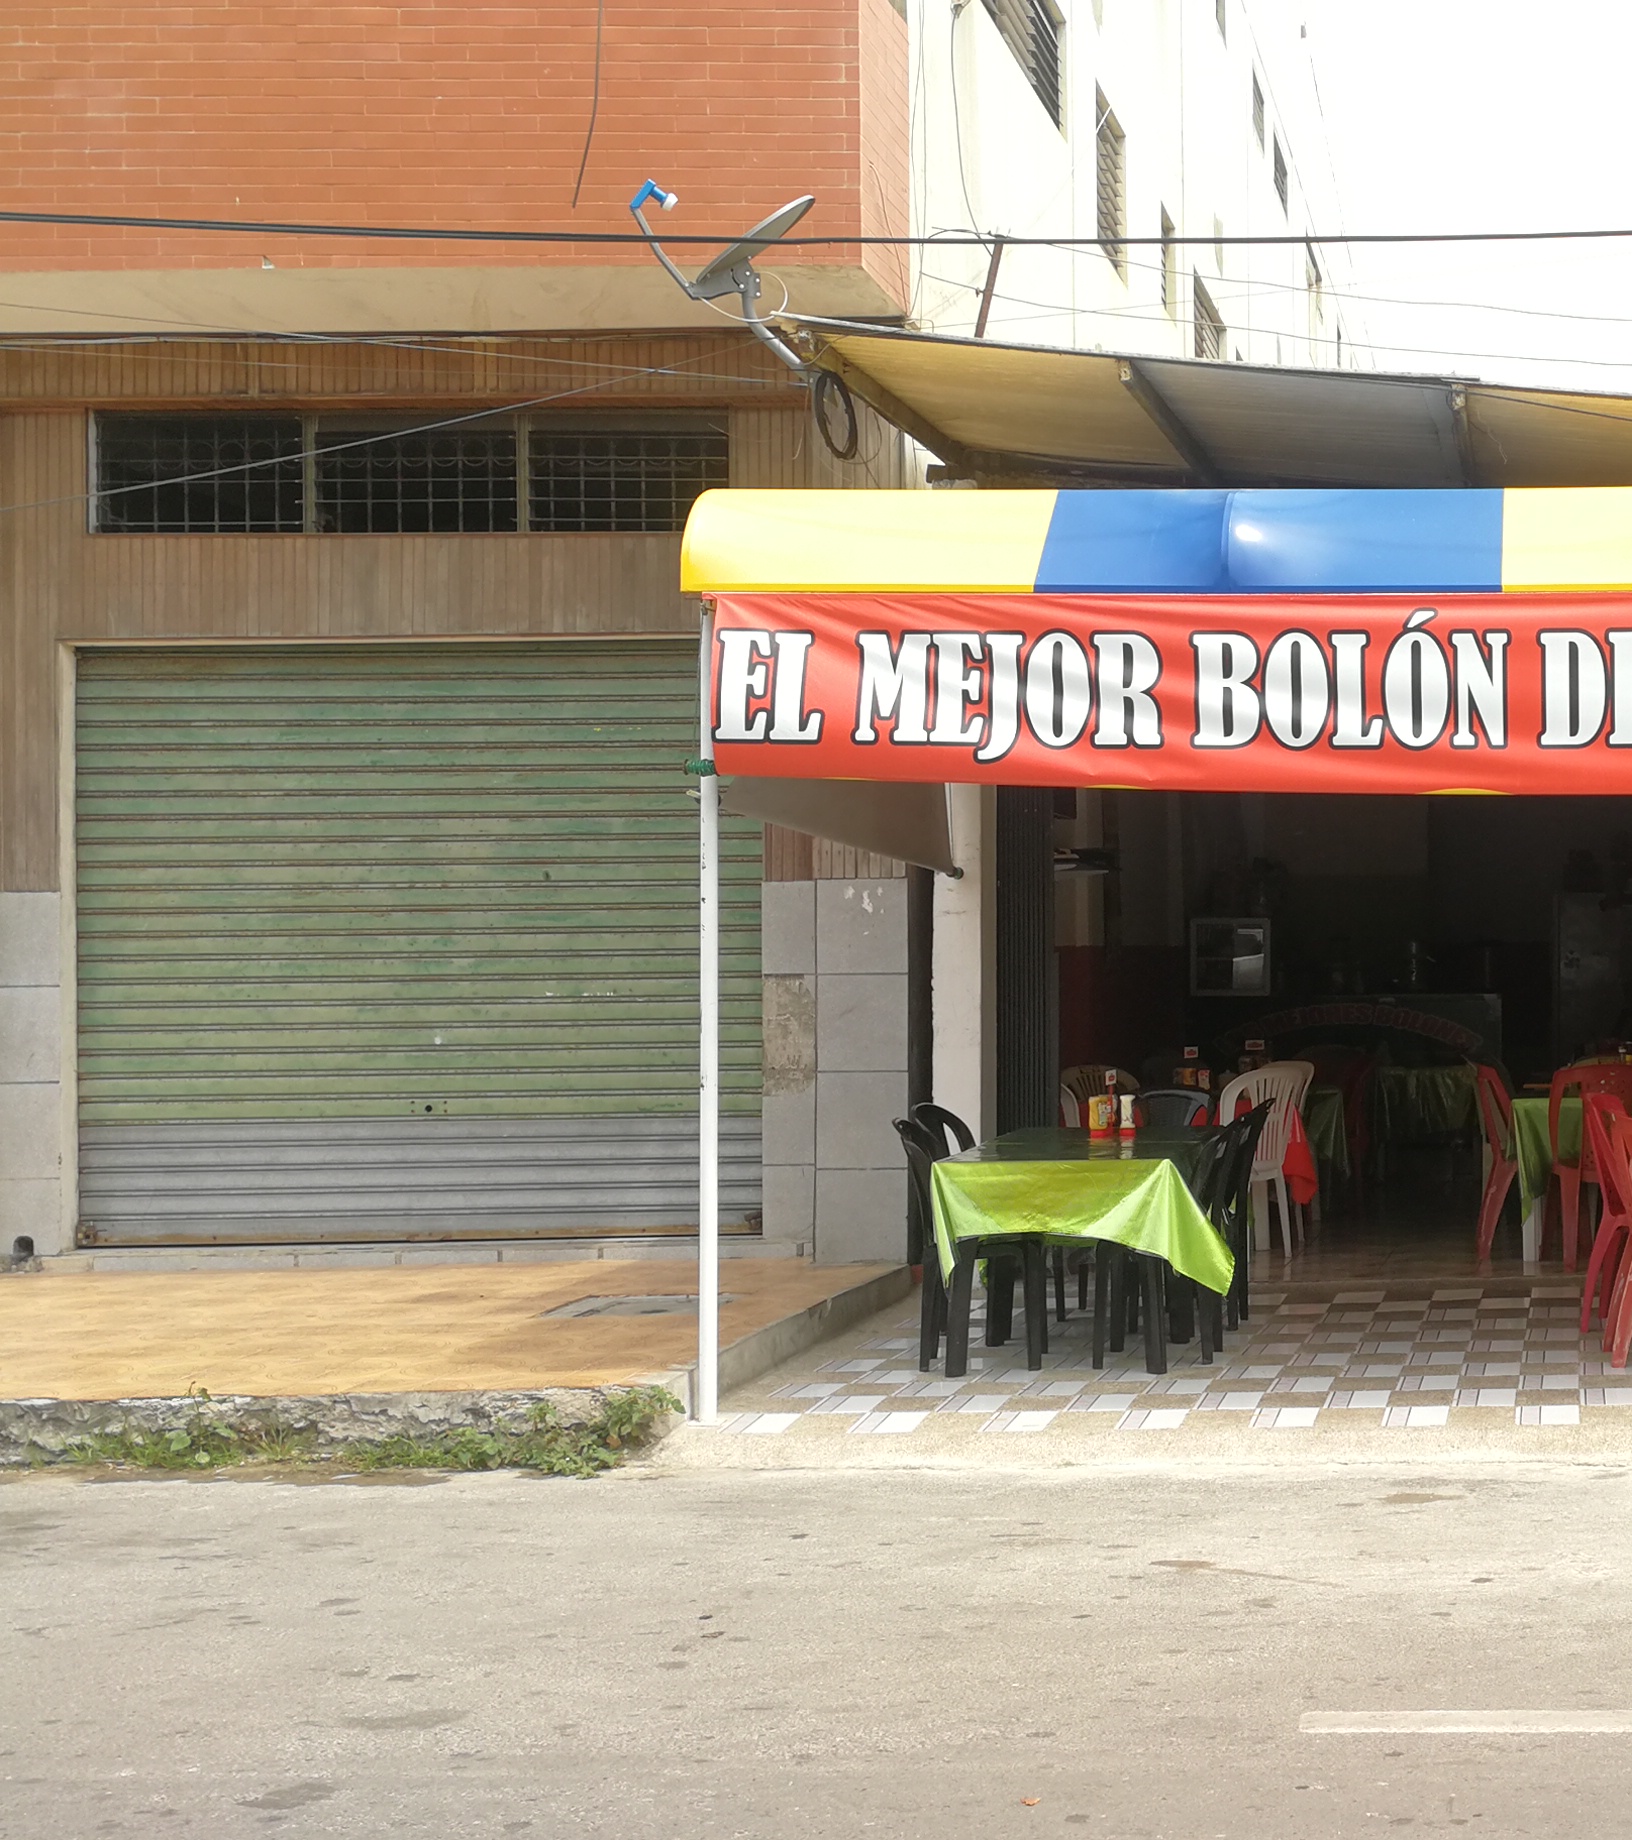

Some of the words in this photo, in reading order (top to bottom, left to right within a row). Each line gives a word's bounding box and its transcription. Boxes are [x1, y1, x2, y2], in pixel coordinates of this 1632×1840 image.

[713, 627, 824, 744] EL
[855, 627, 1163, 763] MEJOR
[1192, 608, 1508, 750] BOLÓN
